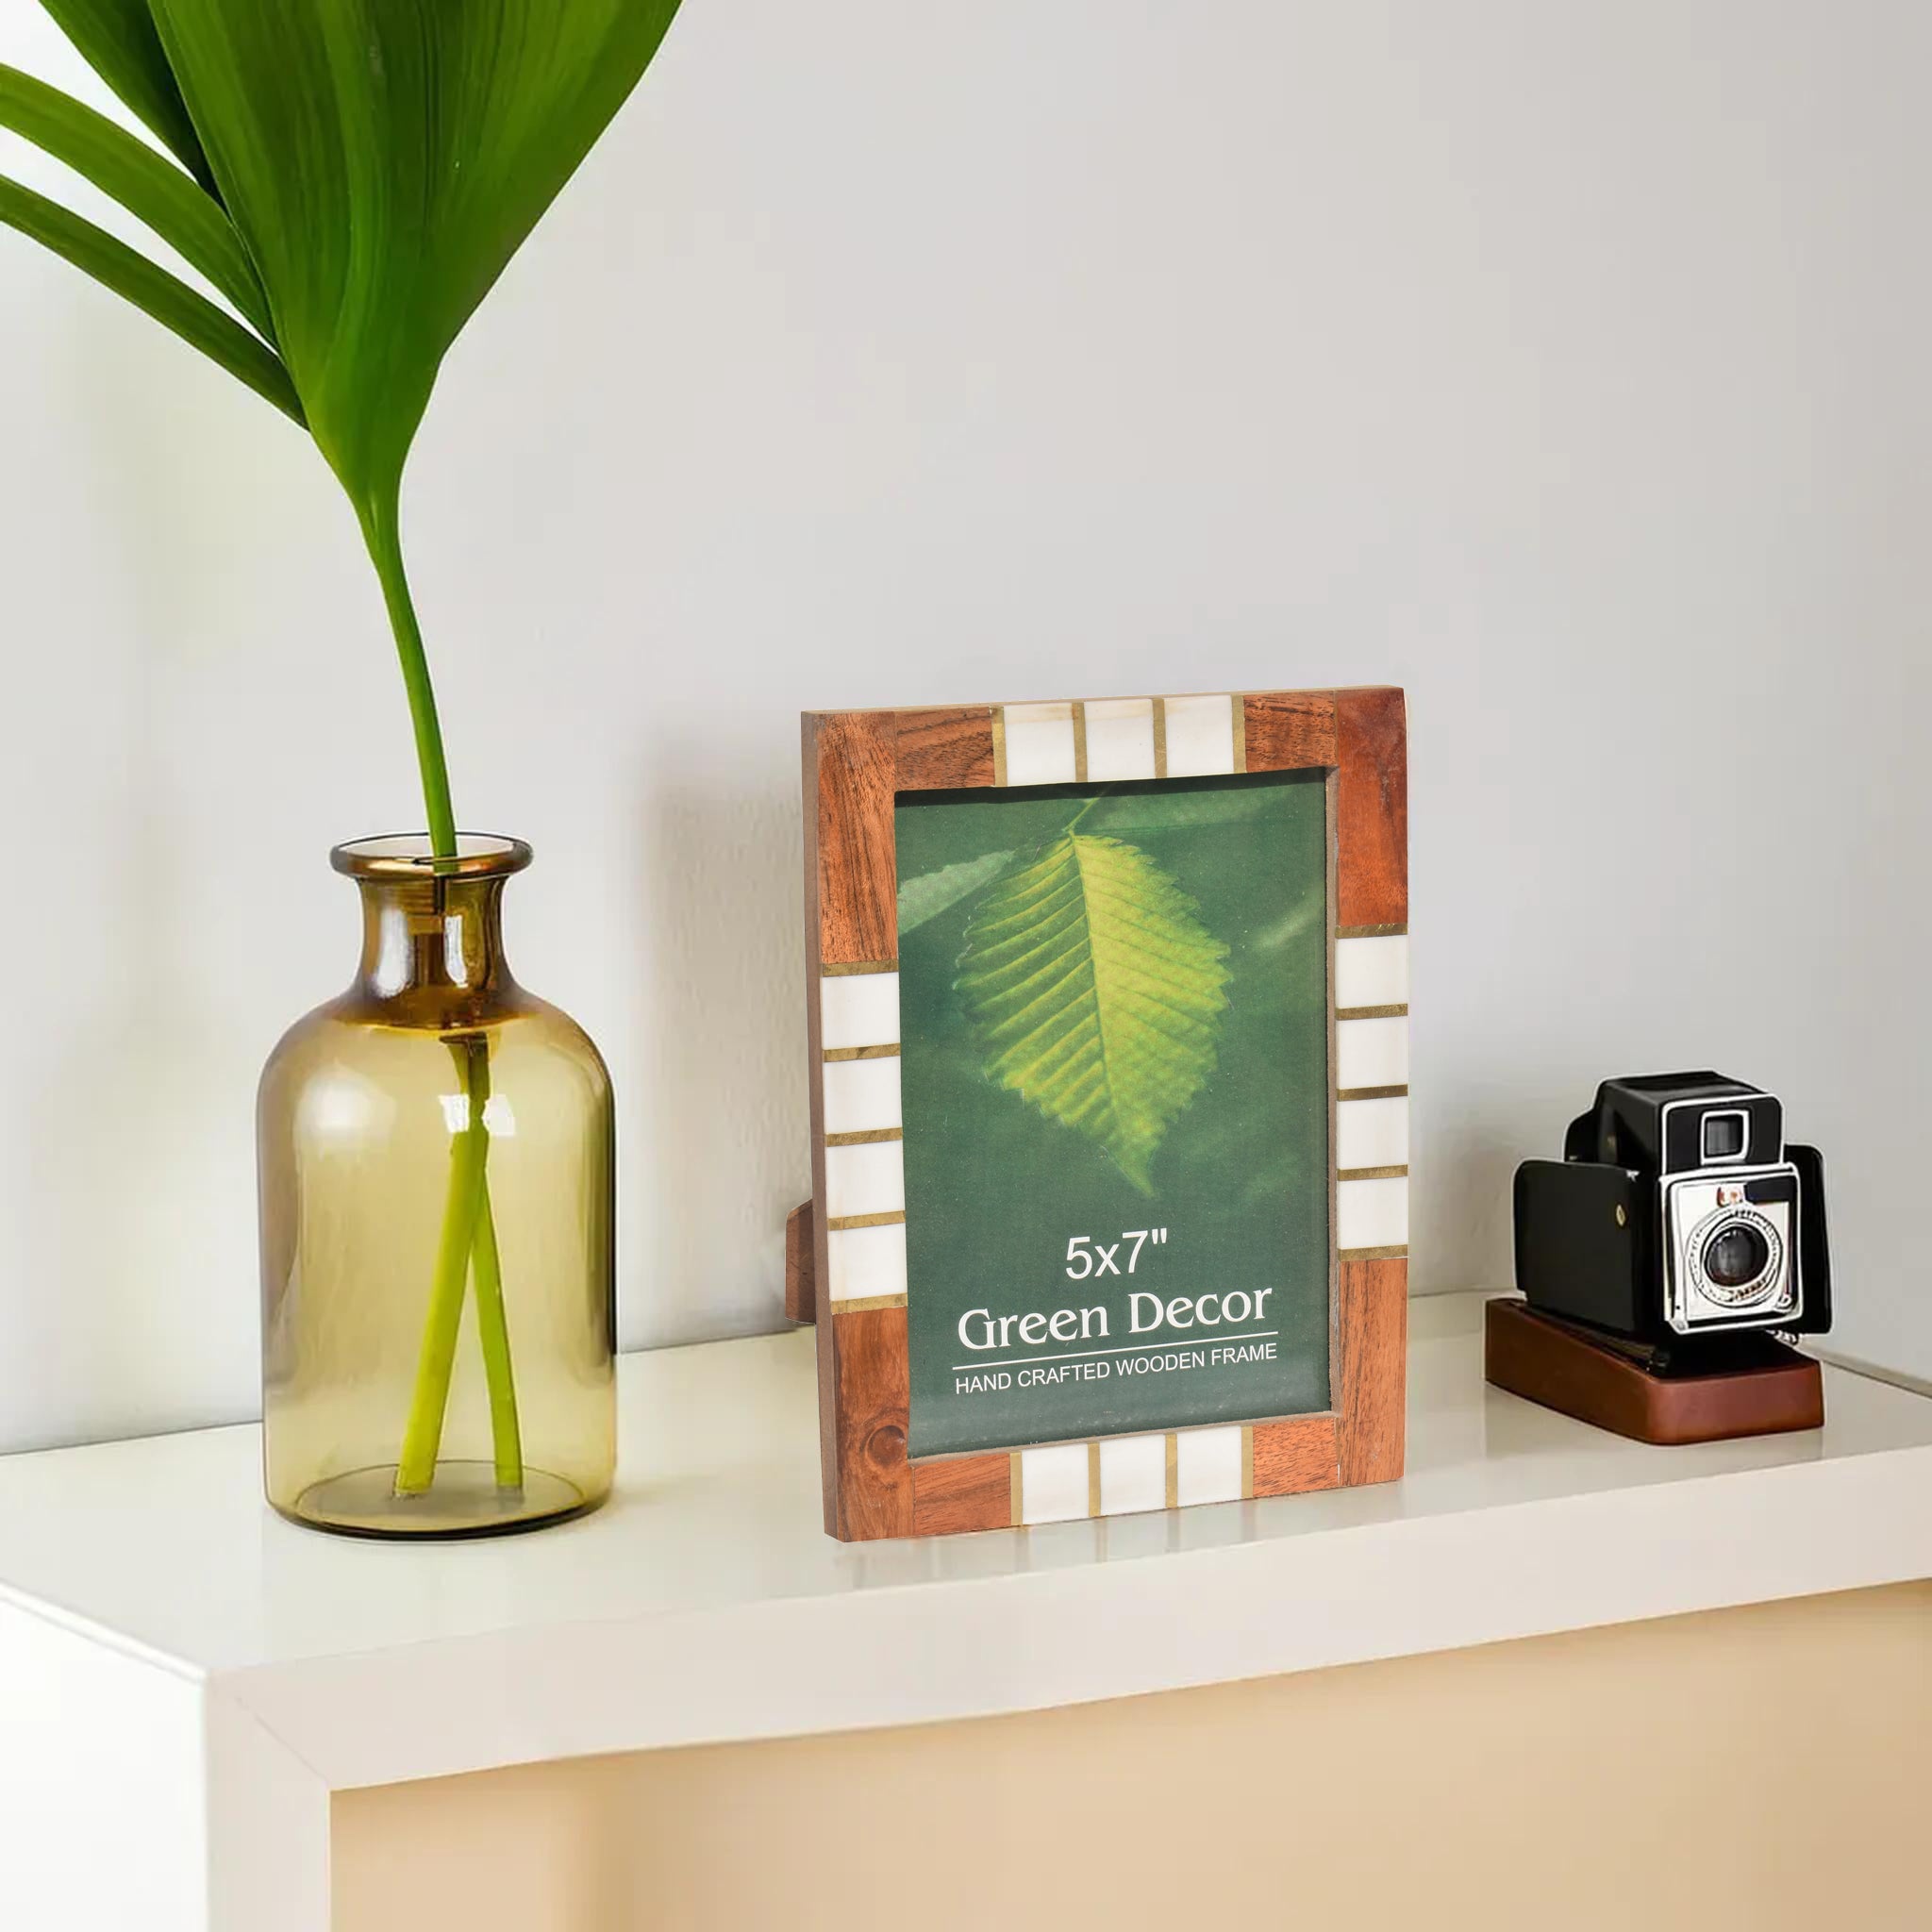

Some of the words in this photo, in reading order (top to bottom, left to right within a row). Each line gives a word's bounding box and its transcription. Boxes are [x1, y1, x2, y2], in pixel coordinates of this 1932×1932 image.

[1065, 1227, 1167, 1280] 5x7"
[958, 1306, 1110, 1350] Green
[1127, 1287, 1273, 1334] Decor
[955, 1372, 1012, 1395] HAND
[1017, 1361, 1110, 1388] CRAFTED
[1115, 1350, 1206, 1376] WOODEN
[1210, 1342, 1278, 1366] FRAME
